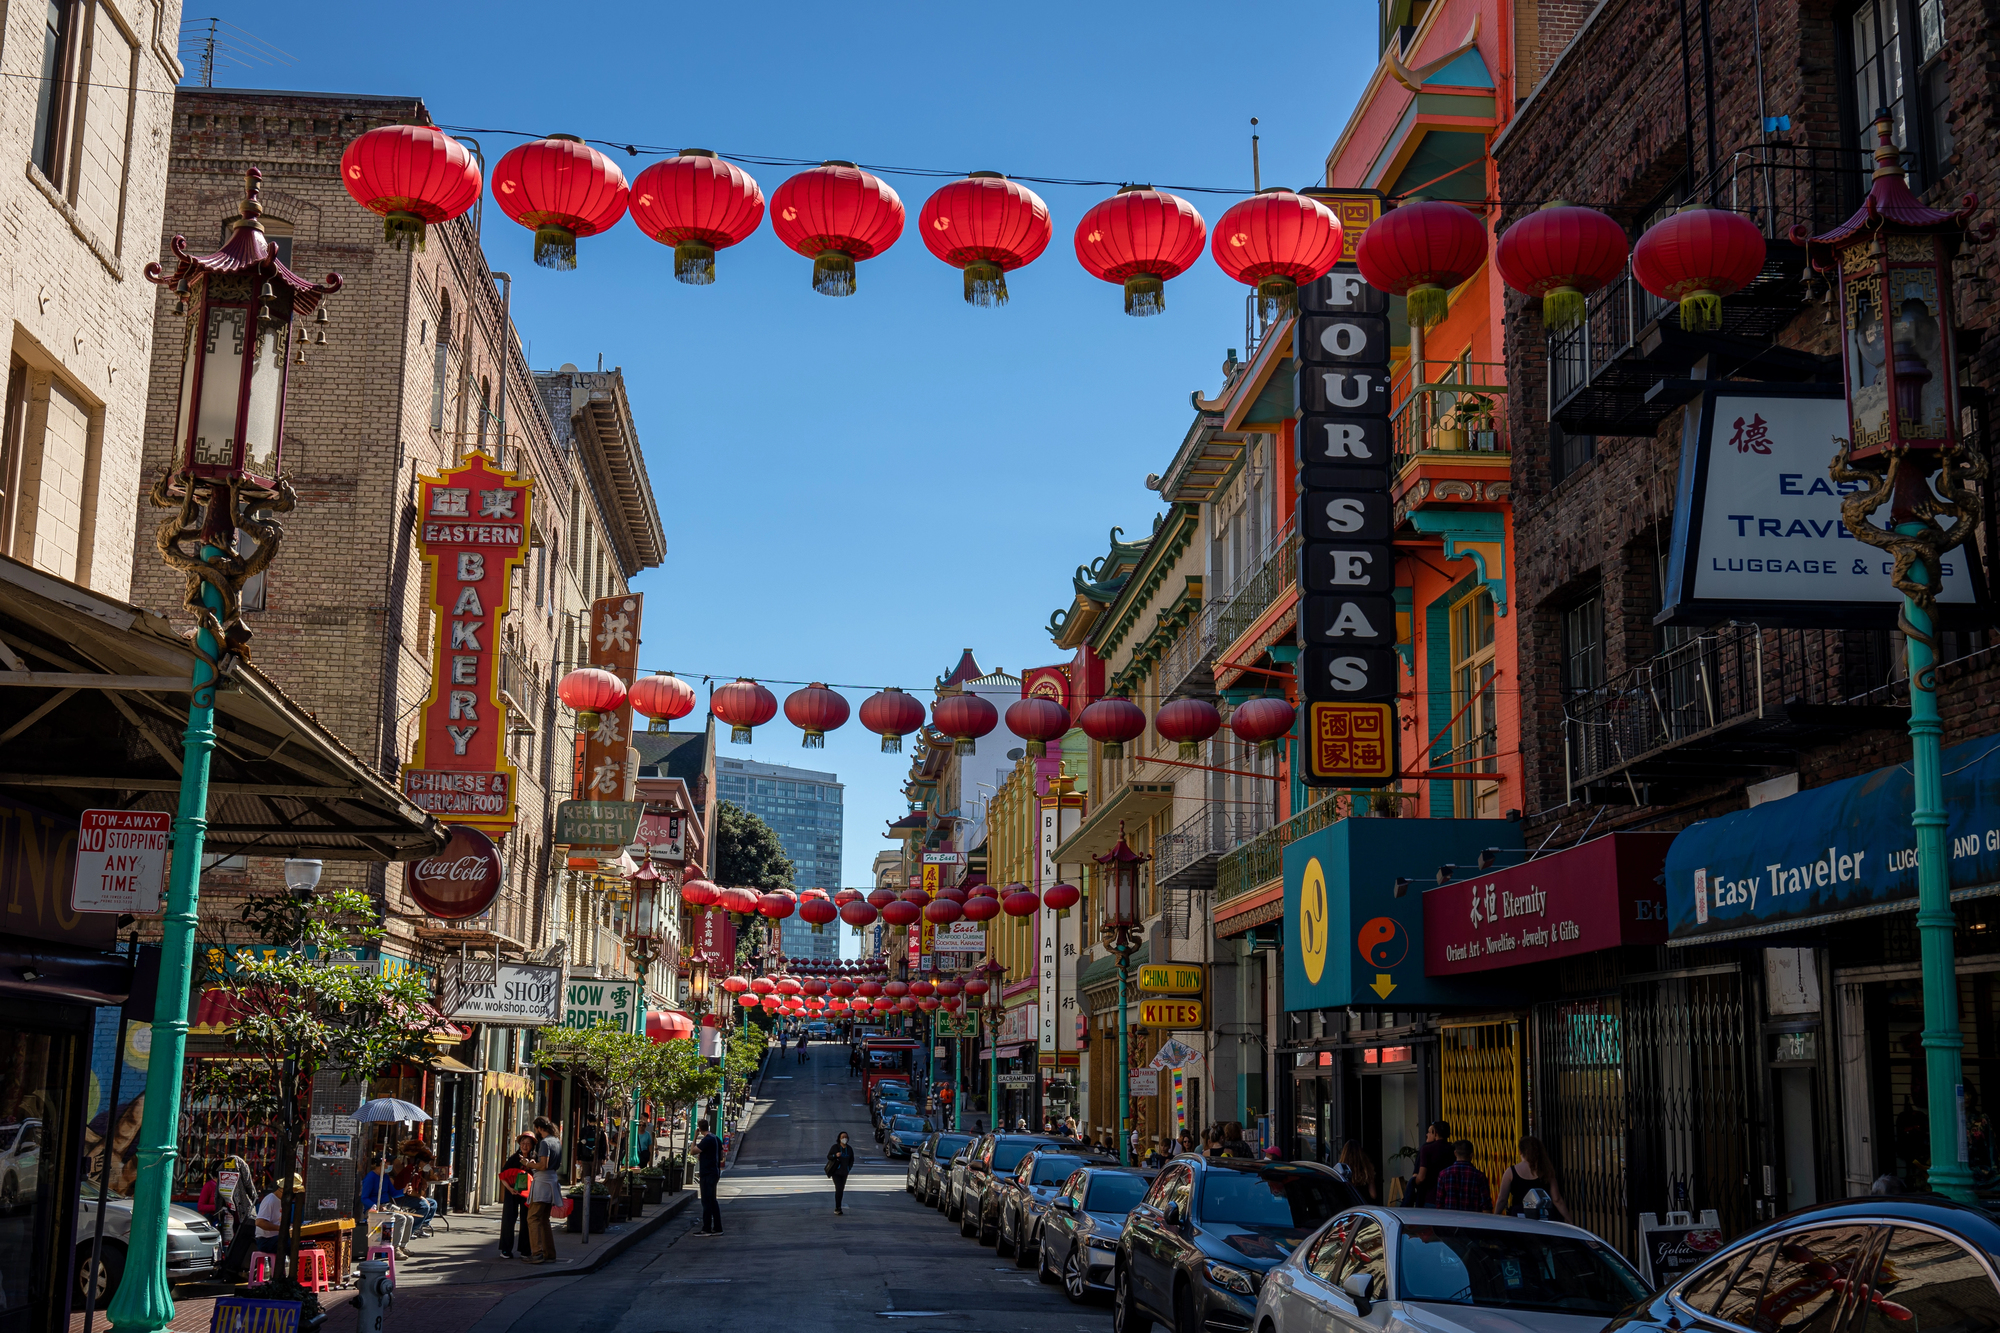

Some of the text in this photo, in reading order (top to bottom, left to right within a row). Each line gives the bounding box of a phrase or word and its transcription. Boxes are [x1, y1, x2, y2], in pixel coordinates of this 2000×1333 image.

[1320, 272, 1373, 459] FOUR
[1729, 412, 1774, 455] 德
[426, 525, 519, 545] EASTERN
[1712, 557, 1837, 575] LUGGAGE
[1852, 559, 1869, 575] &
[1325, 498, 1379, 692] SEAS
[445, 552, 485, 756] BAKERY
[410, 774, 504, 792] CHINESE &
[410, 793, 504, 812] AMERICAN FOOD
[91, 814, 162, 829] TOW-AWAY
[563, 805, 637, 822] REPUBLIC
[80, 828, 165, 851] NO STOPPING
[563, 822, 628, 840] HOTEL
[104, 854, 139, 872] ANY
[1714, 875, 1760, 910] Easy
[1766, 846, 1865, 897] Traveler
[1953, 833, 1980, 860] AND
[101, 874, 138, 892] TIME
[1502, 884, 1547, 919] Eternity
[1446, 920, 1580, 962] Orient Art Novelties Jewelry & Gifts
[1062, 943, 1077, 1010] 銀行
[1143, 969, 1200, 988] CHINA TOWN
[455, 976, 552, 1003] WOK SHOP
[1044, 937, 1053, 1043] America
[1146, 1005, 1197, 1023] KITES
[1131, 1068, 1139, 1077] NO
